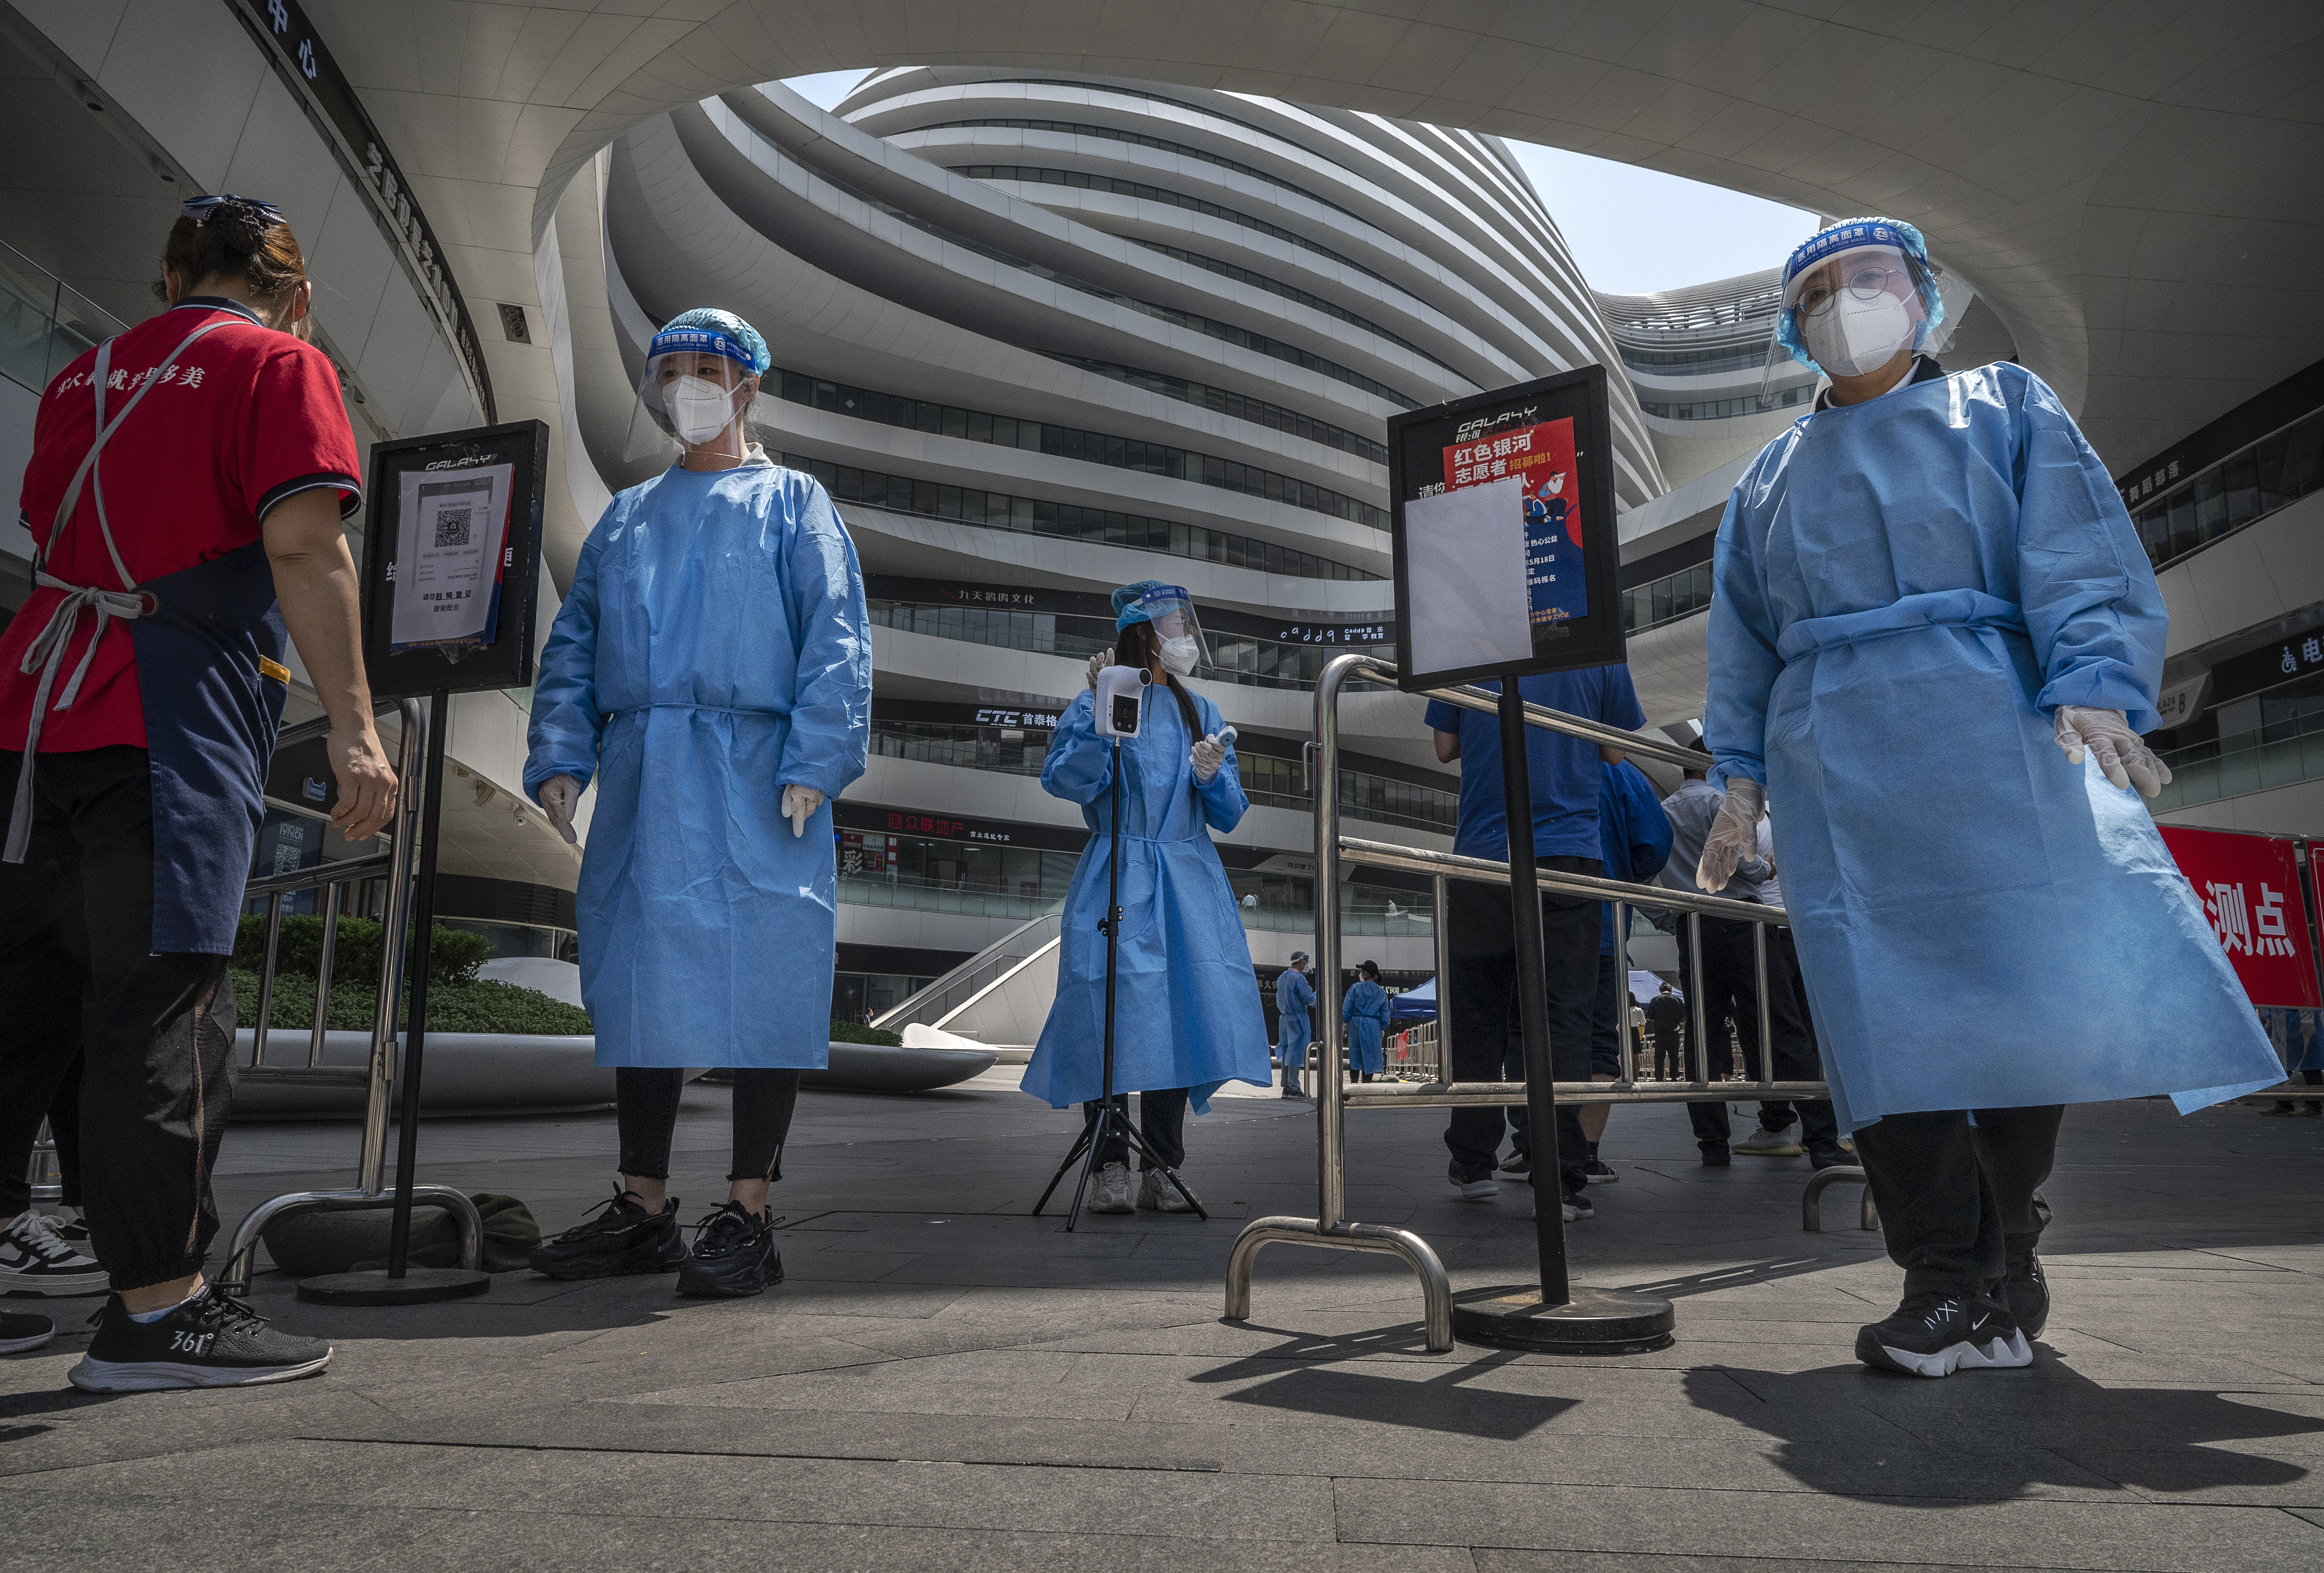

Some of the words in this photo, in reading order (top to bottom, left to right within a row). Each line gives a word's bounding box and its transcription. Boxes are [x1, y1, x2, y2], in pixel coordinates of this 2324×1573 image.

[1798, 228, 1865, 263] 医用隔离面罩
[1799, 253, 1818, 267] MEDICAL
[1820, 240, 1849, 254] ISOLATION
[658, 333, 708, 346] 医用隔离面罩
[1454, 433, 1532, 467] 红色银河
[1455, 459, 1507, 484] 志愿者
[1530, 535, 1558, 546] 热心公益
[423, 589, 471, 601] 请您扫码登记
[959, 590, 1034, 604] 九天鹤鸣文化
[433, 603, 460, 613] 谢谢配合
[2302, 635, 2324, 663] 电
[2179, 693, 2186, 714] B
[976, 709, 1020, 724] CTC
[905, 815, 964, 835] 众联地产
[970, 831, 1010, 841] 商业选址专家
[888, 837, 898, 861] 彩票
[843, 849, 863, 874] 彩
[170, 1331, 214, 1353] 361°
